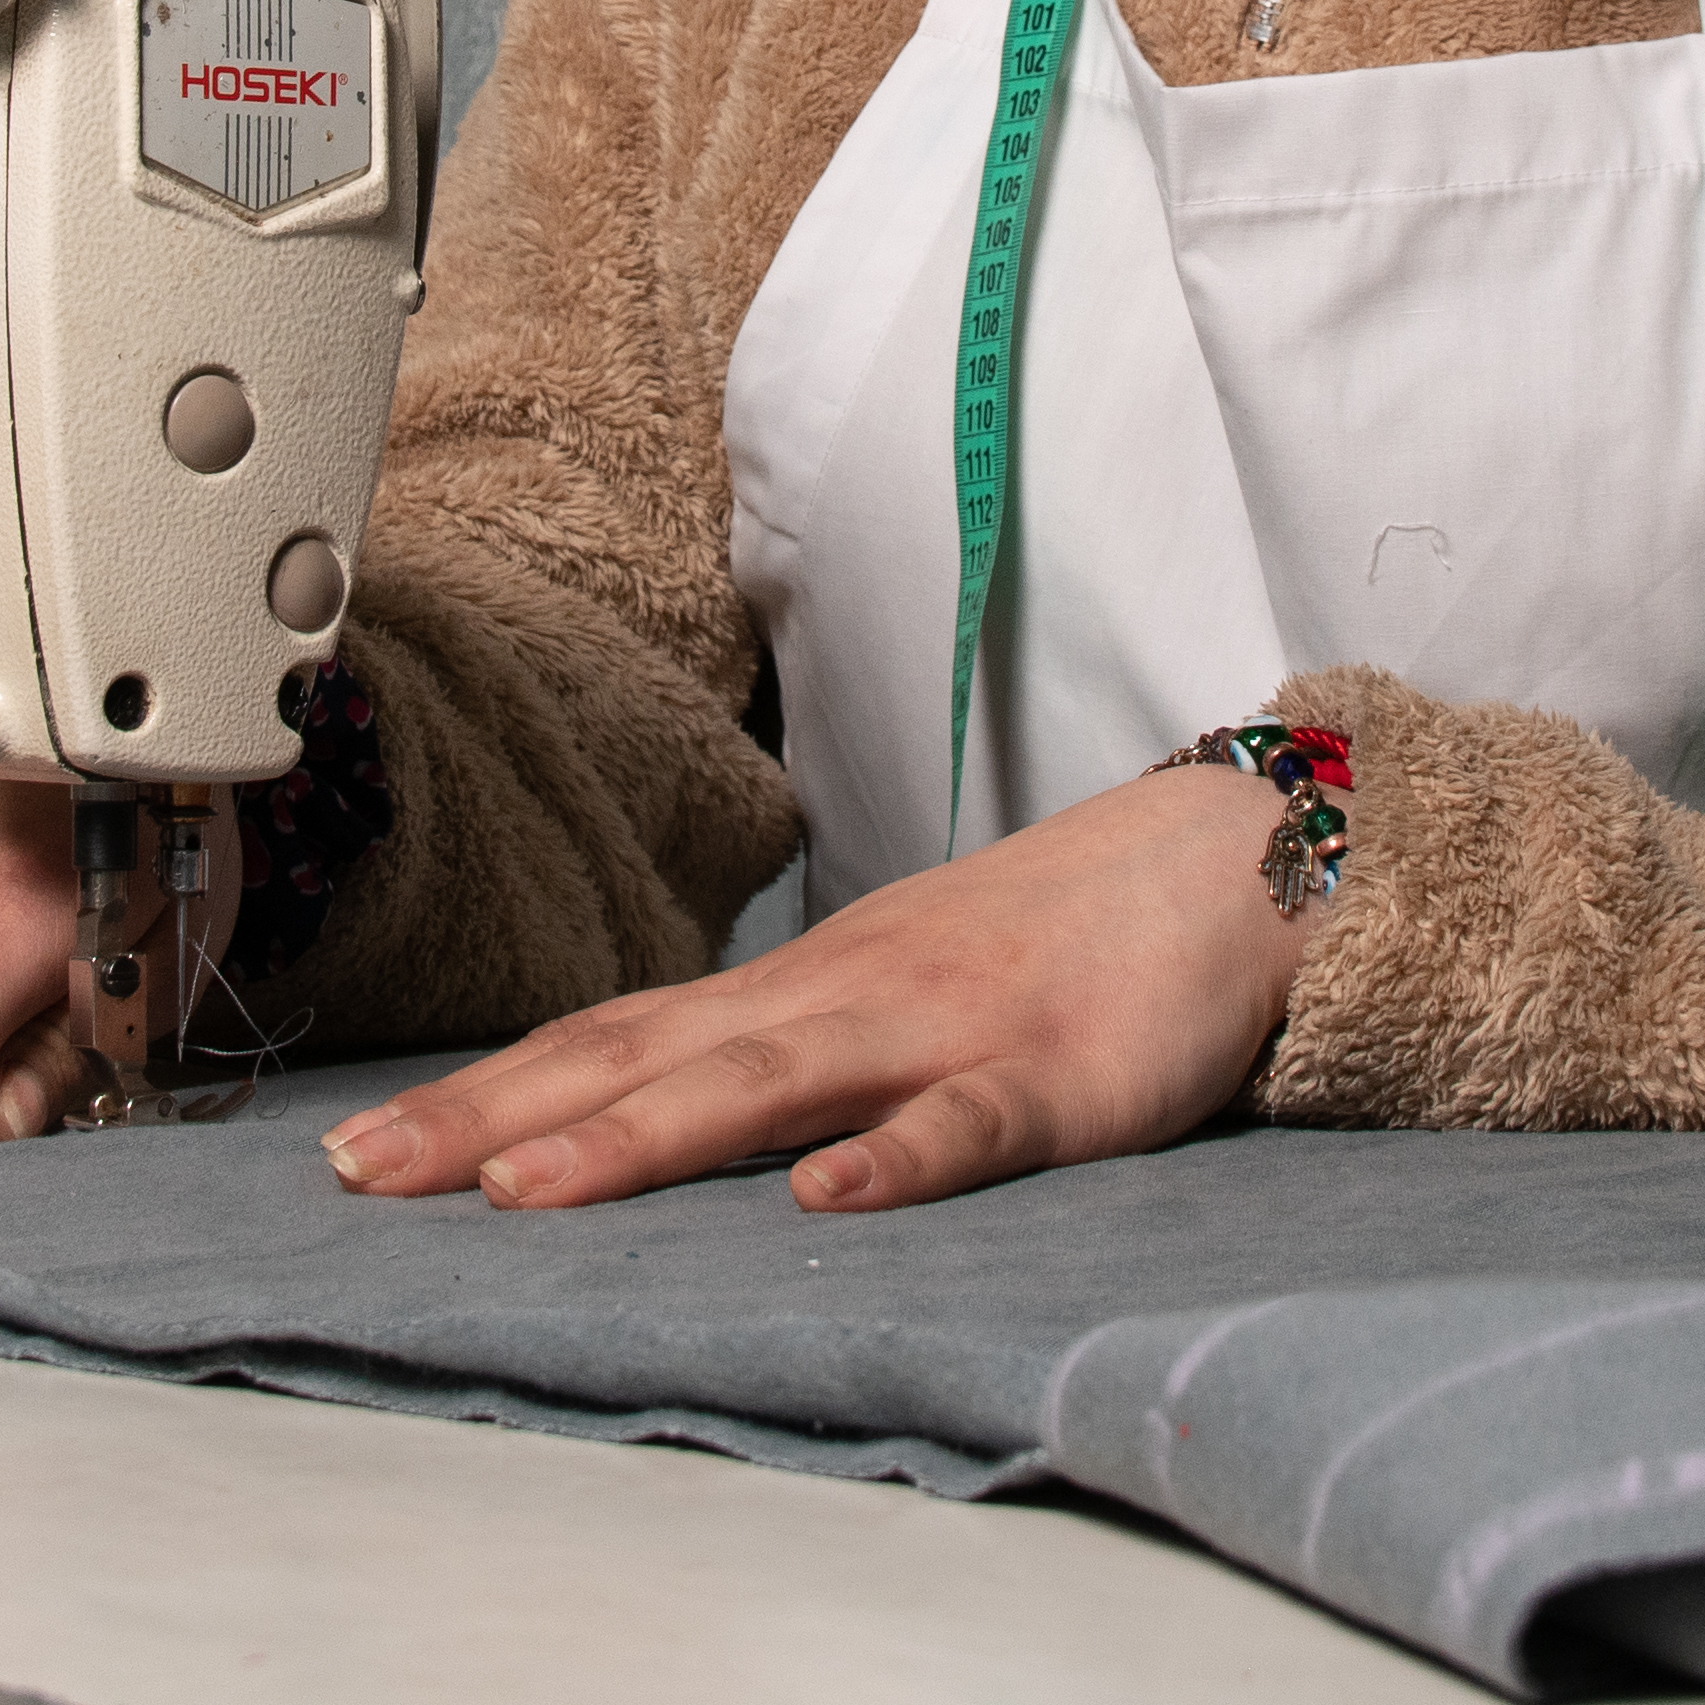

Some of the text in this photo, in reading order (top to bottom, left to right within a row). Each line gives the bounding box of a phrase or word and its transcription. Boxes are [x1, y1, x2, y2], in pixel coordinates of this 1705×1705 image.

[1022, 3, 1055, 31] 101
[1015, 45, 1047, 75] 102
[181, 63, 337, 107] HOSEKI
[1009, 89, 1040, 118] 103
[1001, 132, 1031, 162] 104
[994, 174, 1022, 205] 105
[986, 218, 1012, 247] 106
[978, 262, 1005, 294] 107
[973, 307, 1000, 339] 108
[968, 353, 996, 385] 109
[966, 400, 993, 432] 110
[965, 449, 991, 479] 111
[968, 494, 993, 526] 112
